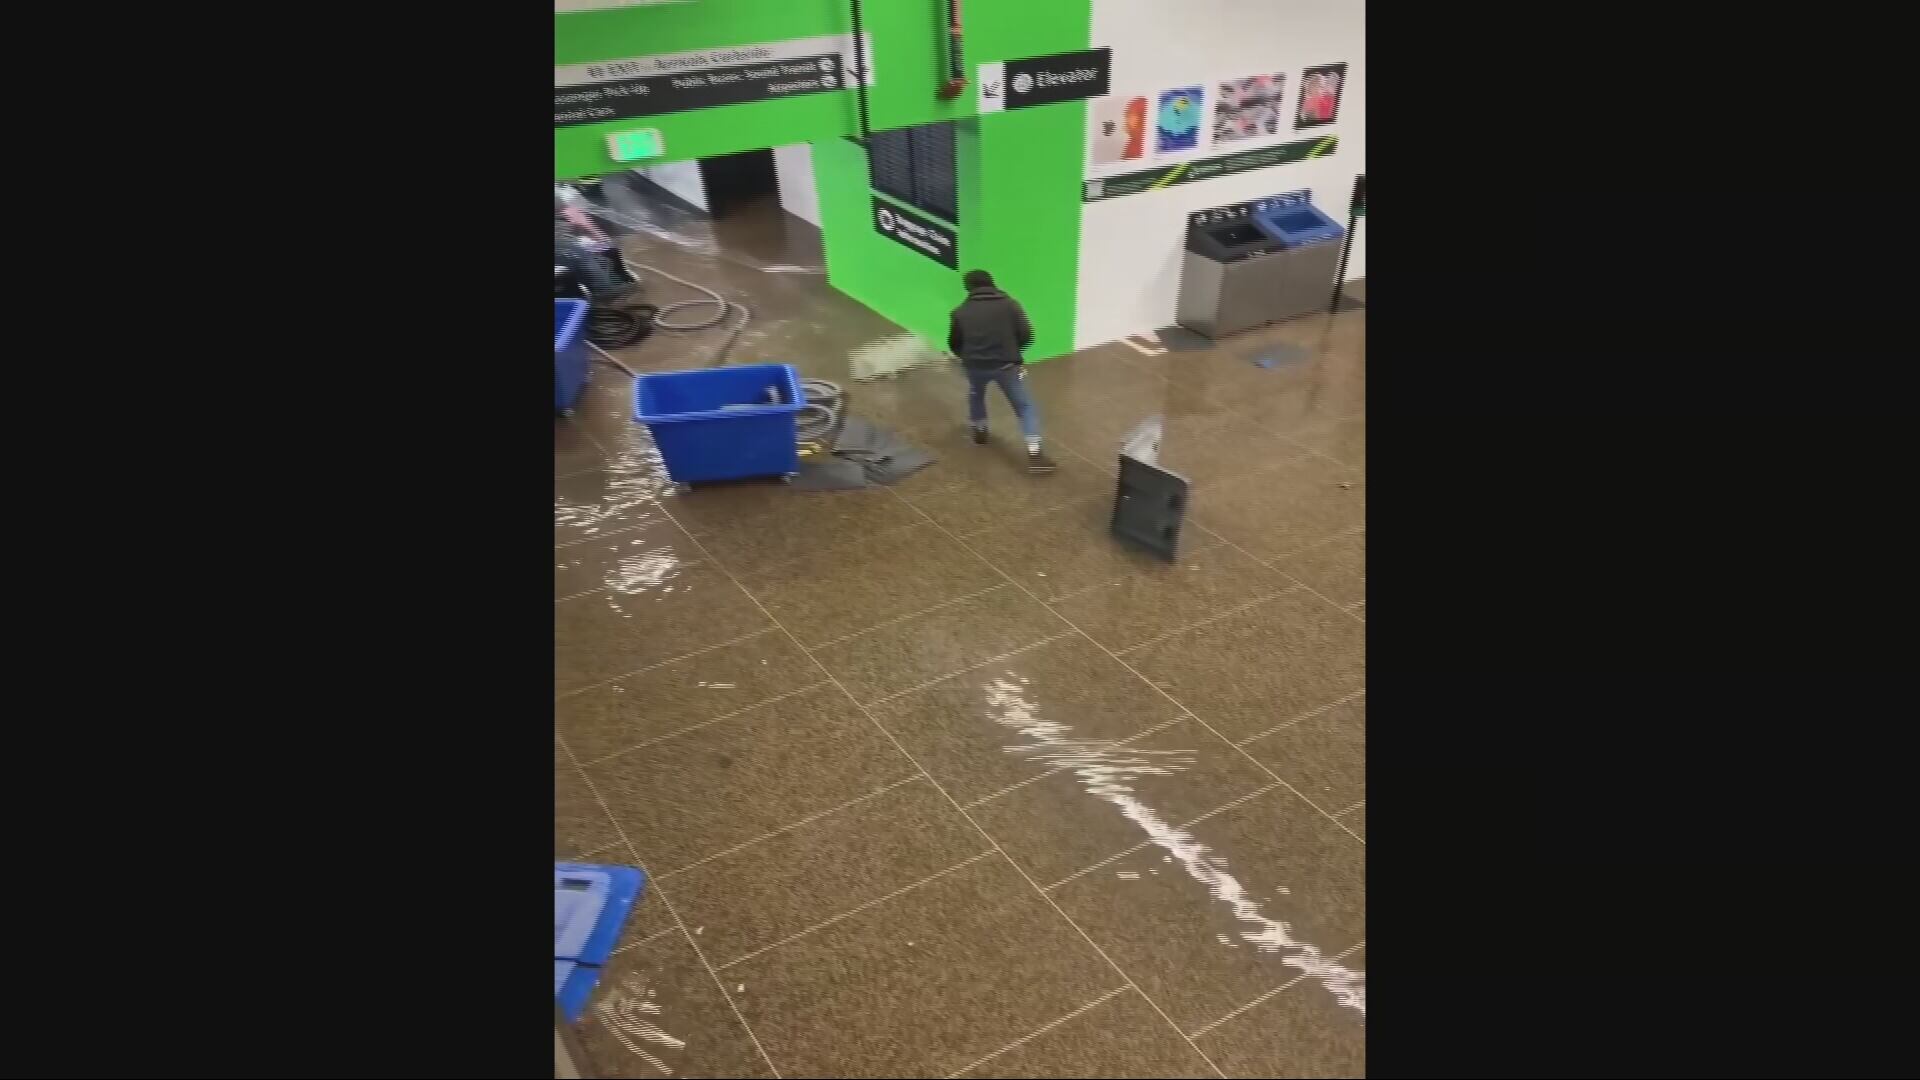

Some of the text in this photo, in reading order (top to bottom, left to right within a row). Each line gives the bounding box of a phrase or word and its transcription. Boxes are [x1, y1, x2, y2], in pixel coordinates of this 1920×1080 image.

[607, 62, 640, 77] EXIT
[654, 54, 708, 71] Arrivals
[672, 75, 708, 90] Public
[745, 67, 780, 80] Sound
[780, 62, 817, 75] Transit
[1036, 68, 1099, 88] Elevator
[604, 84, 650, 99] Pick-Up
[768, 80, 820, 95] Airporters
[554, 106, 615, 123] ental Cars
